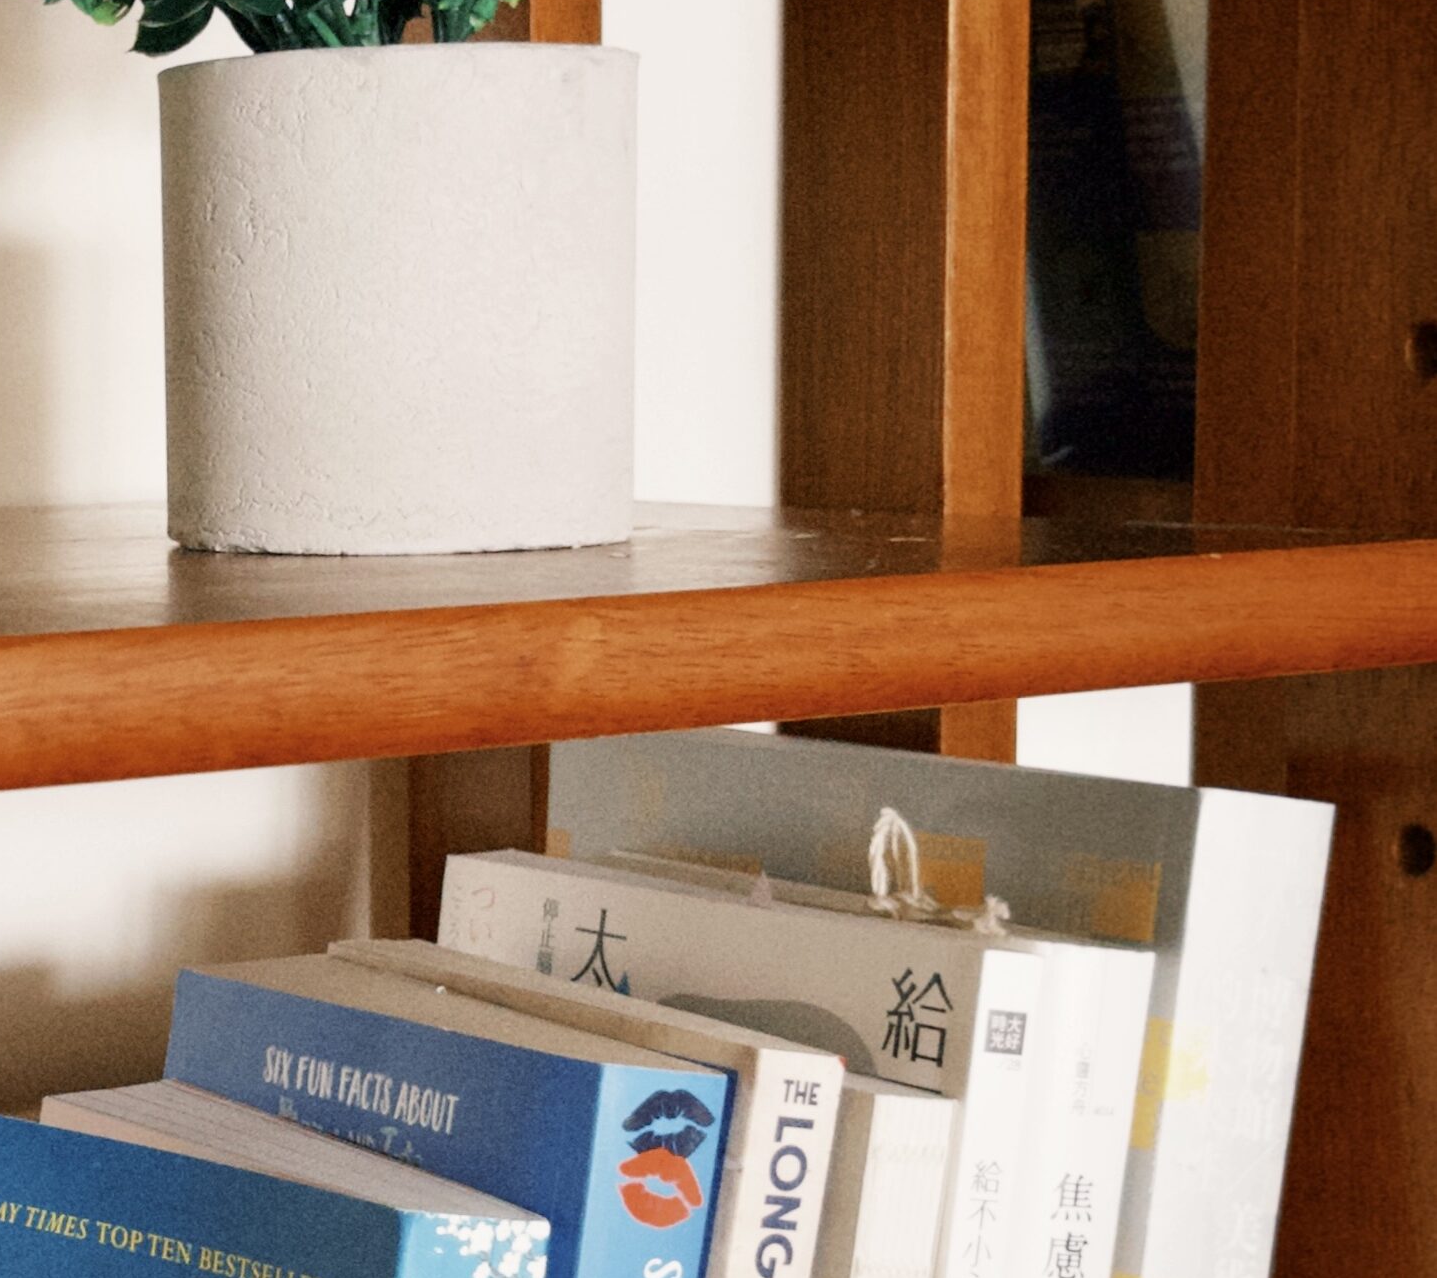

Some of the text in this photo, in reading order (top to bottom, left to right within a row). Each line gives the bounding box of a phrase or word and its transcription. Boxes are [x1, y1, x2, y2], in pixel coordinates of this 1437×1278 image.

[571, 908, 628, 992] 太
[881, 967, 955, 1068] 給
[263, 1044, 294, 1090] SIX
[295, 1054, 335, 1100] FUN
[338, 1065, 393, 1116] FACTS
[393, 1081, 461, 1135] ABOUT
[784, 1078, 821, 1106] THE
[24, 1205, 90, 1240] TIMES
[95, 1220, 144, 1253] TOP
[146, 1232, 193, 1265] TEN
